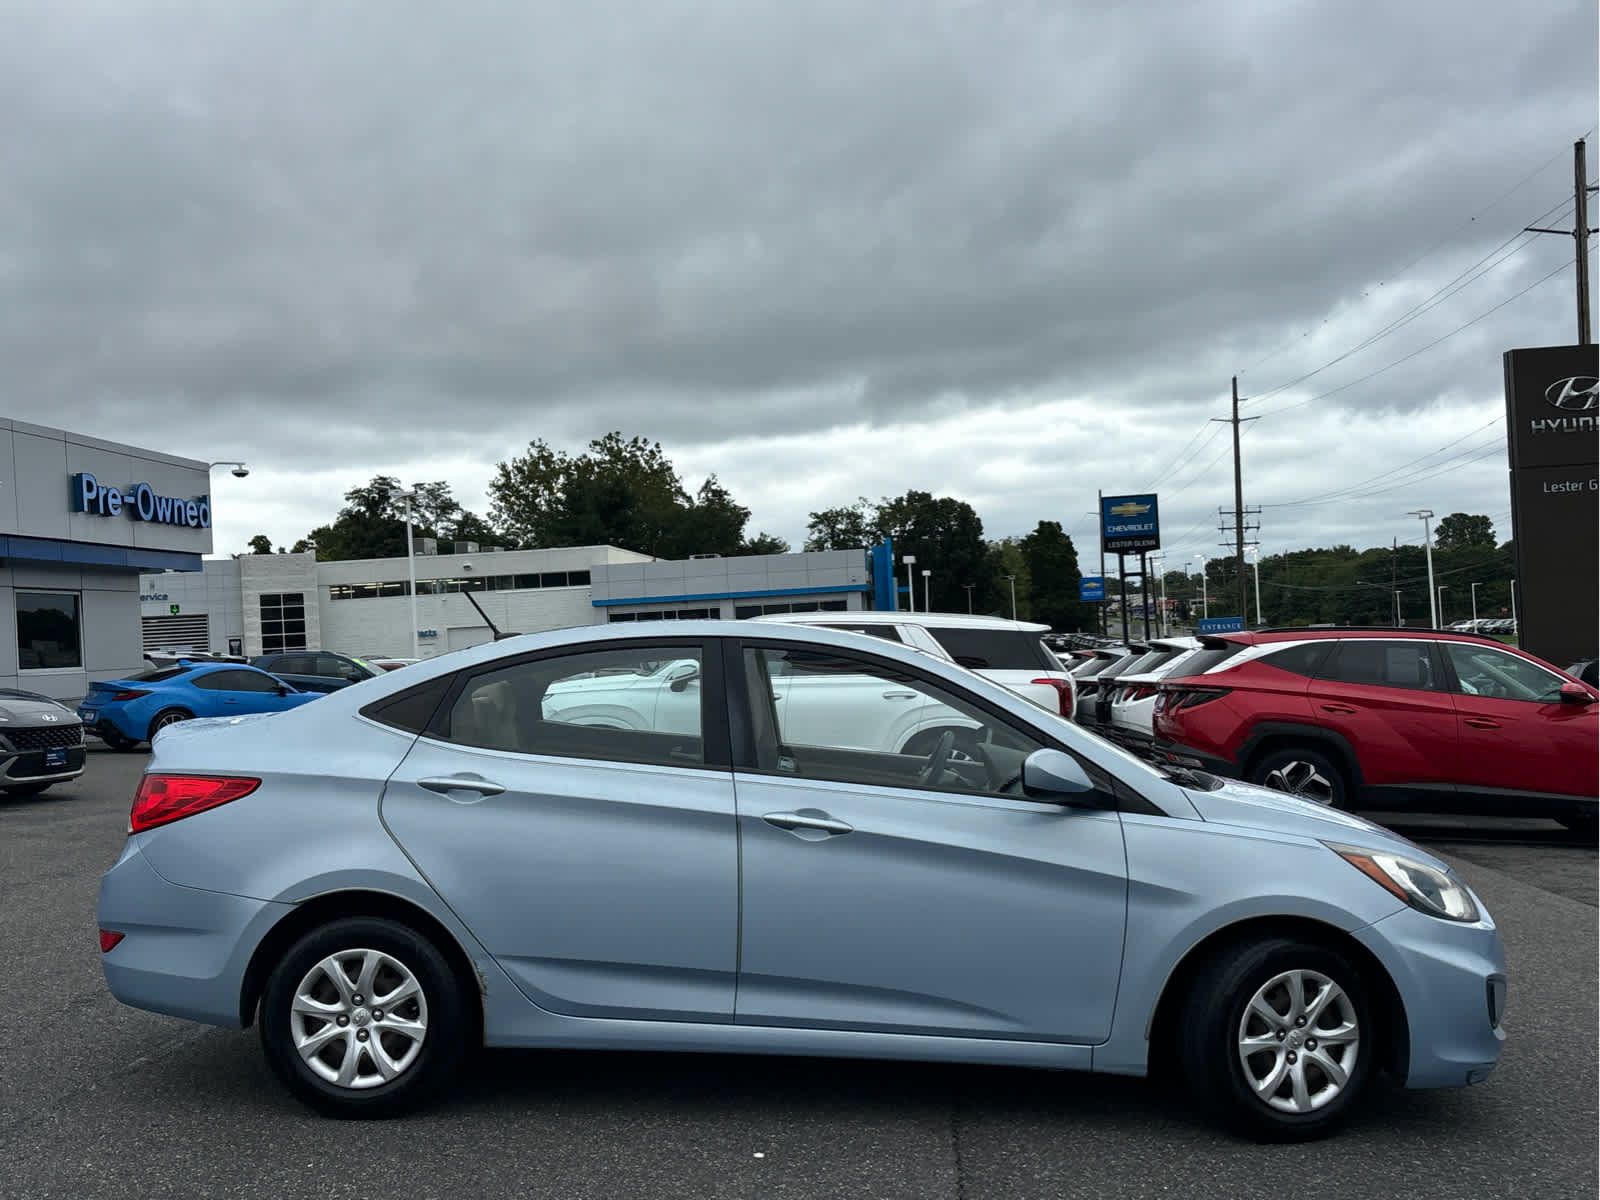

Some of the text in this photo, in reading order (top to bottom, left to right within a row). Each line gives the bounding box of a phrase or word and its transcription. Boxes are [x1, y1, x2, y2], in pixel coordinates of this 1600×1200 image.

[1531, 416, 1599, 433] HYUN
[1543, 480, 1584, 493] Lester
[74, 472, 210, 528] Pre-Owned
[1107, 523, 1153, 532] CHEVROLET
[140, 593, 168, 601] ervice
[1201, 622, 1241, 630] ENTRANCE
